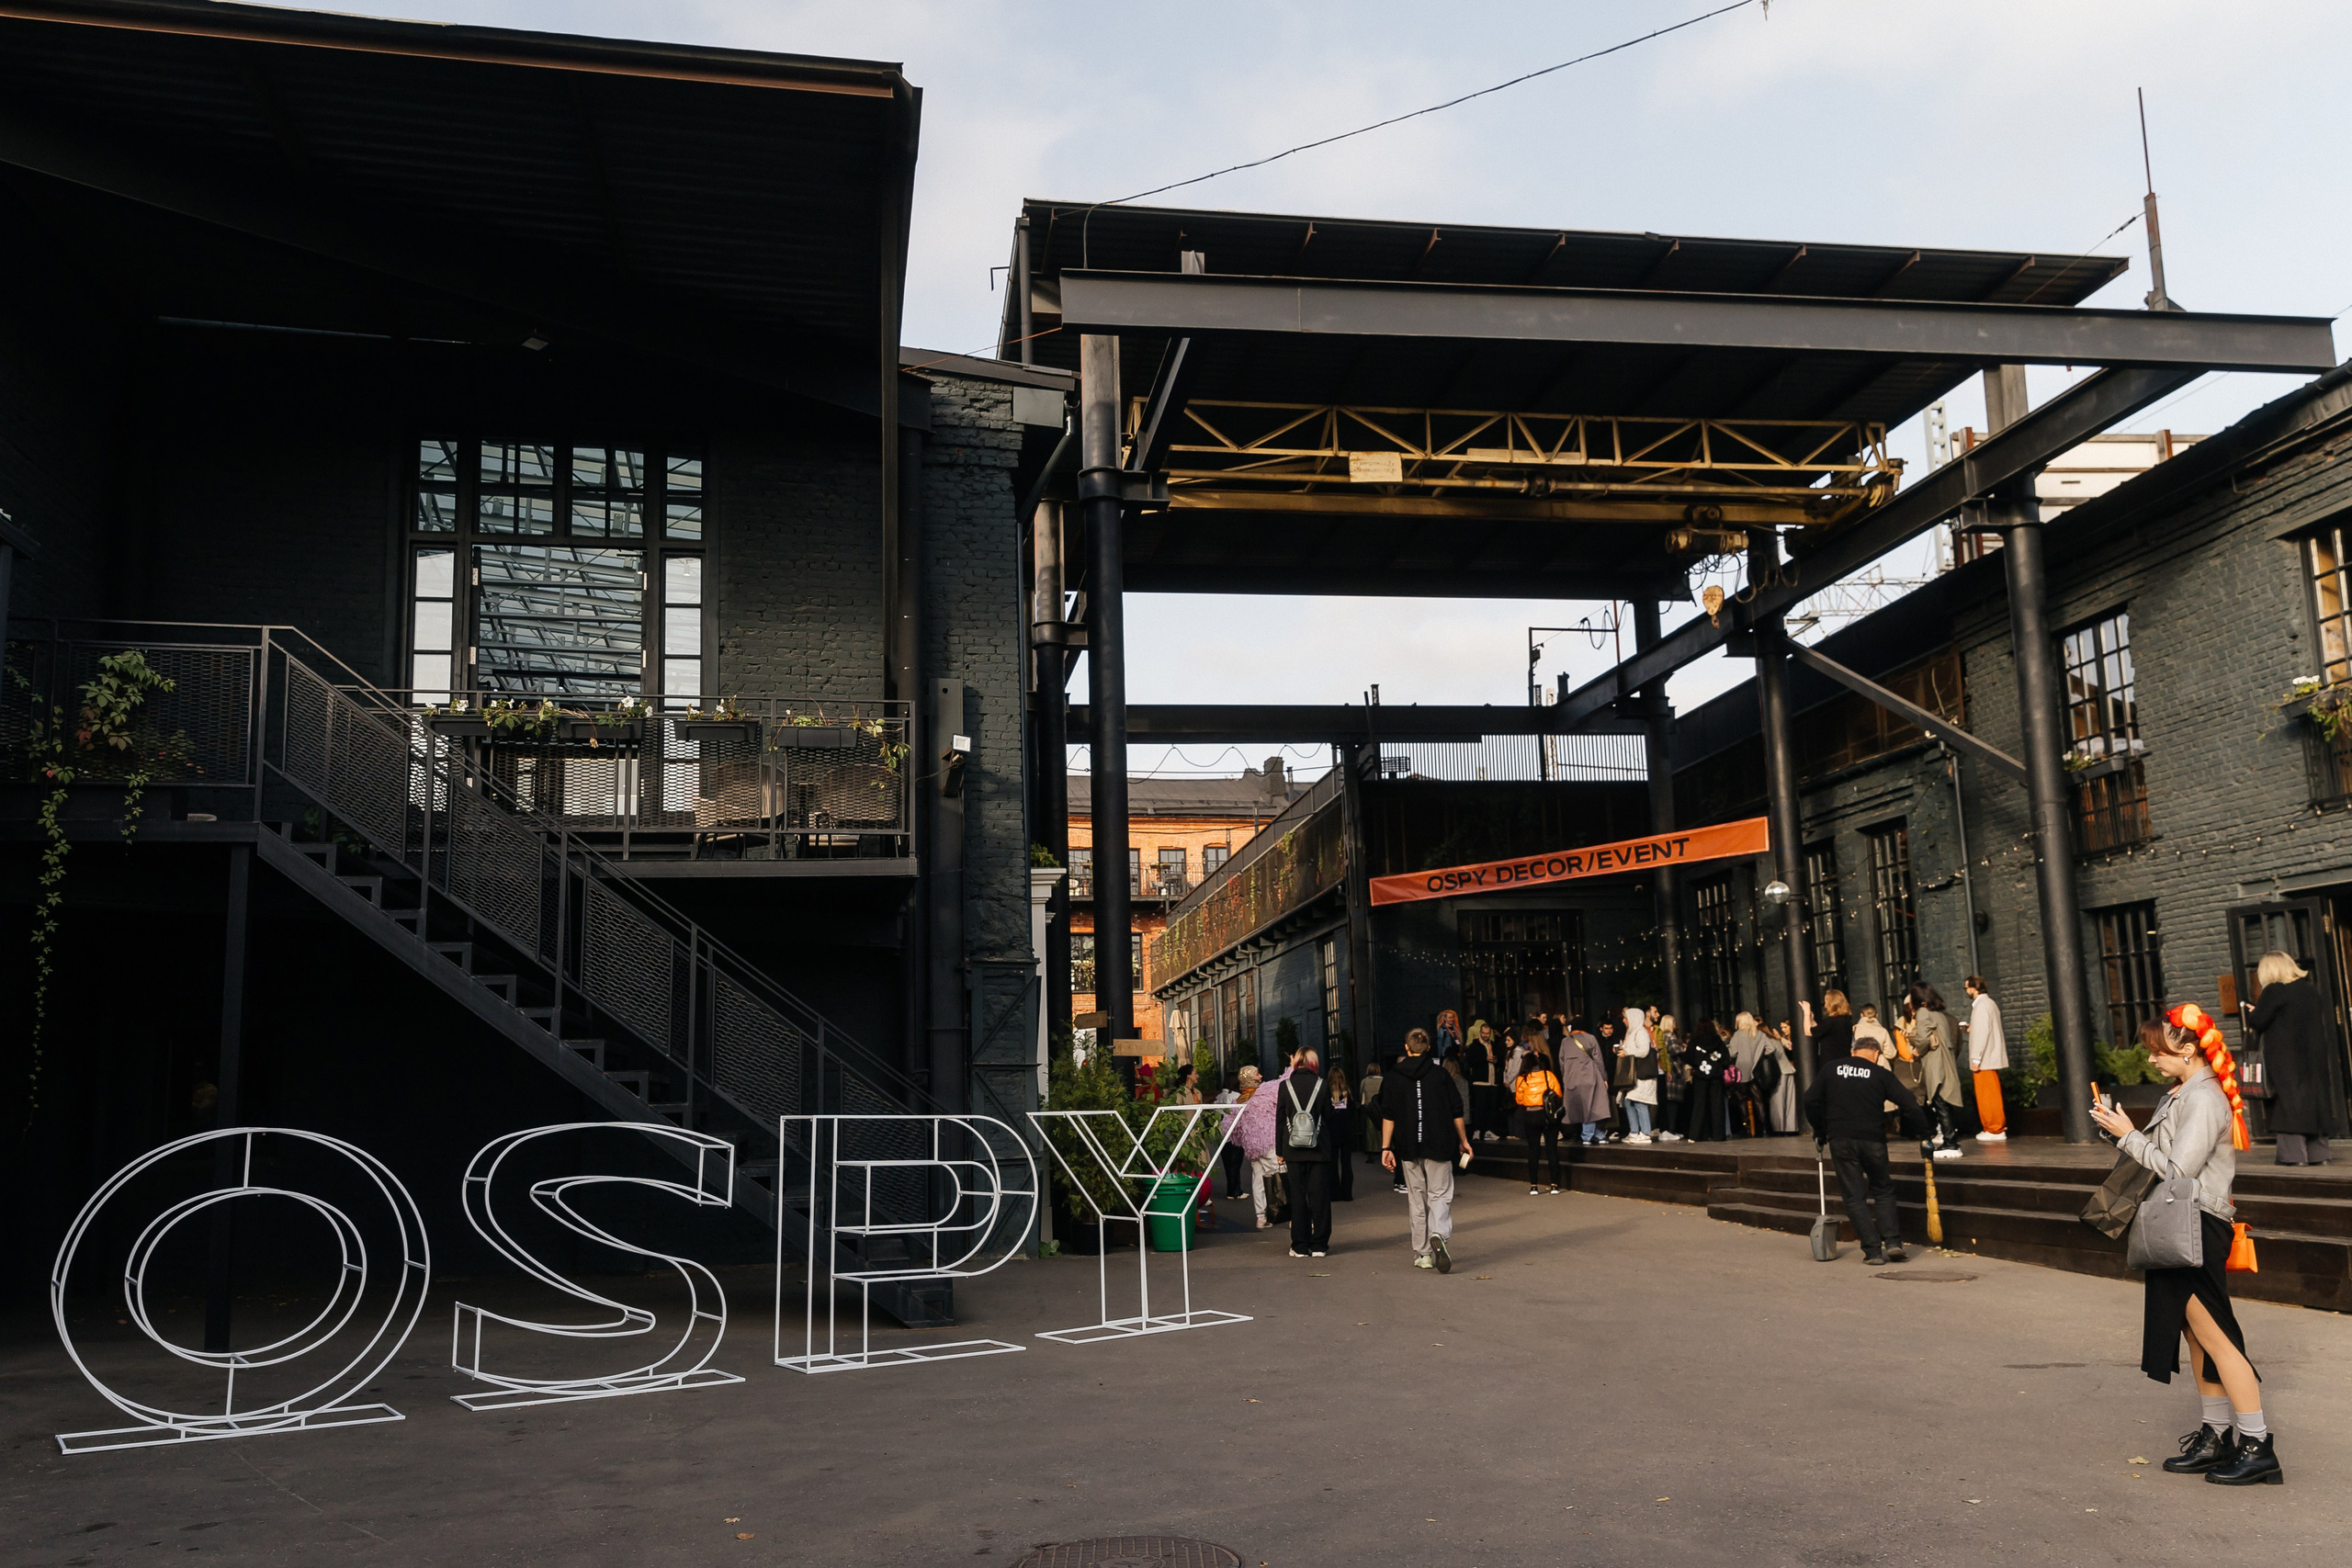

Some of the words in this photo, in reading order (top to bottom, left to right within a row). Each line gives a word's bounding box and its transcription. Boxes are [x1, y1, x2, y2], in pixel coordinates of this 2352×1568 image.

[1427, 868, 1487, 892] OSPY
[1497, 838, 1690, 883] DECOR/EVENT
[51, 1104, 1250, 1444] OSPY
